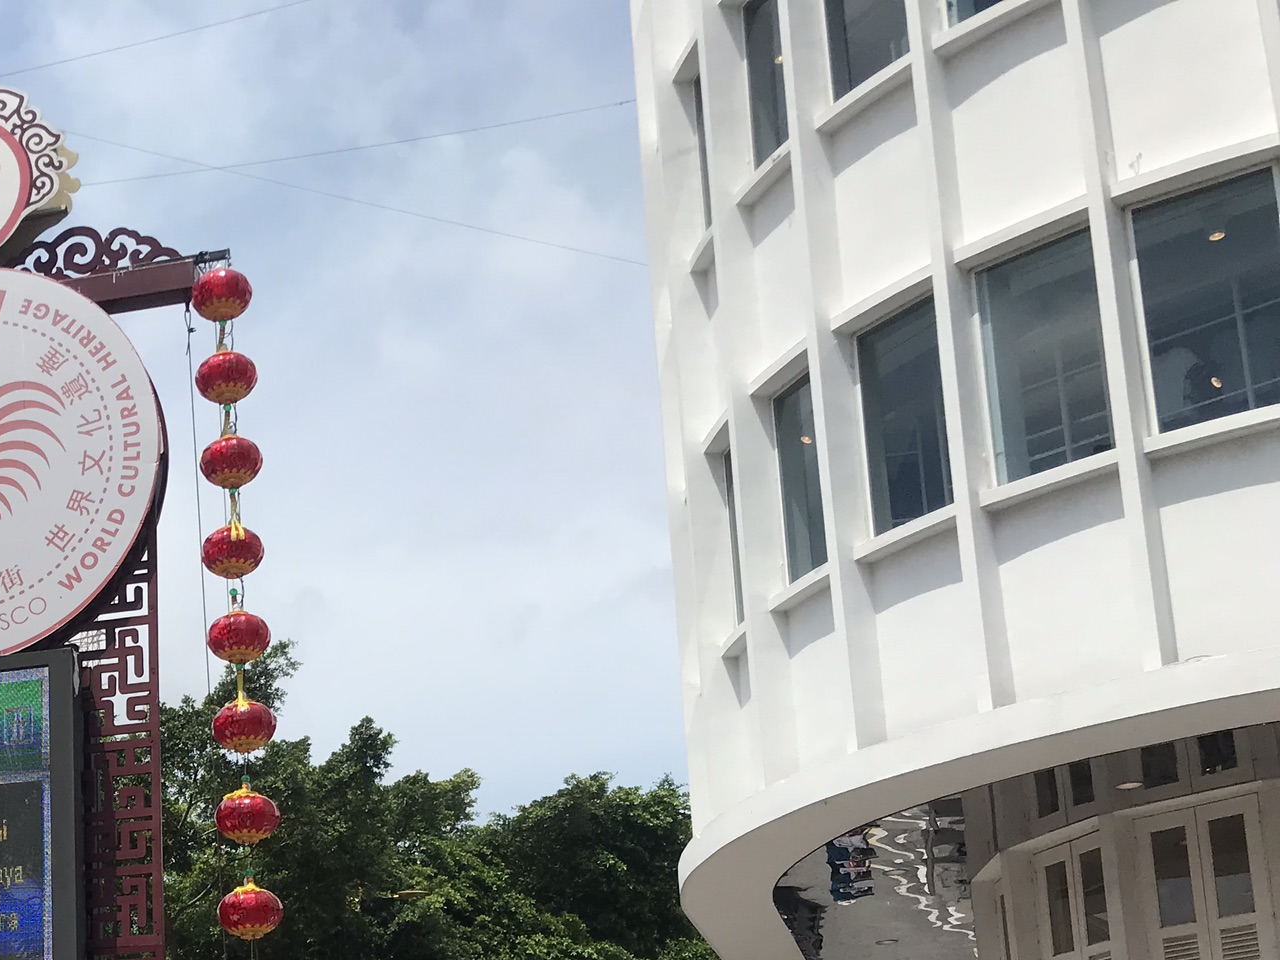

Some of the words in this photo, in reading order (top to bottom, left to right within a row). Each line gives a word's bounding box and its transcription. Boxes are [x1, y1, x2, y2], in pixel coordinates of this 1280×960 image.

[19, 299, 117, 372] HERITAGE
[111, 373, 141, 498] CULTURAL
[57, 508, 125, 591] WORLD
